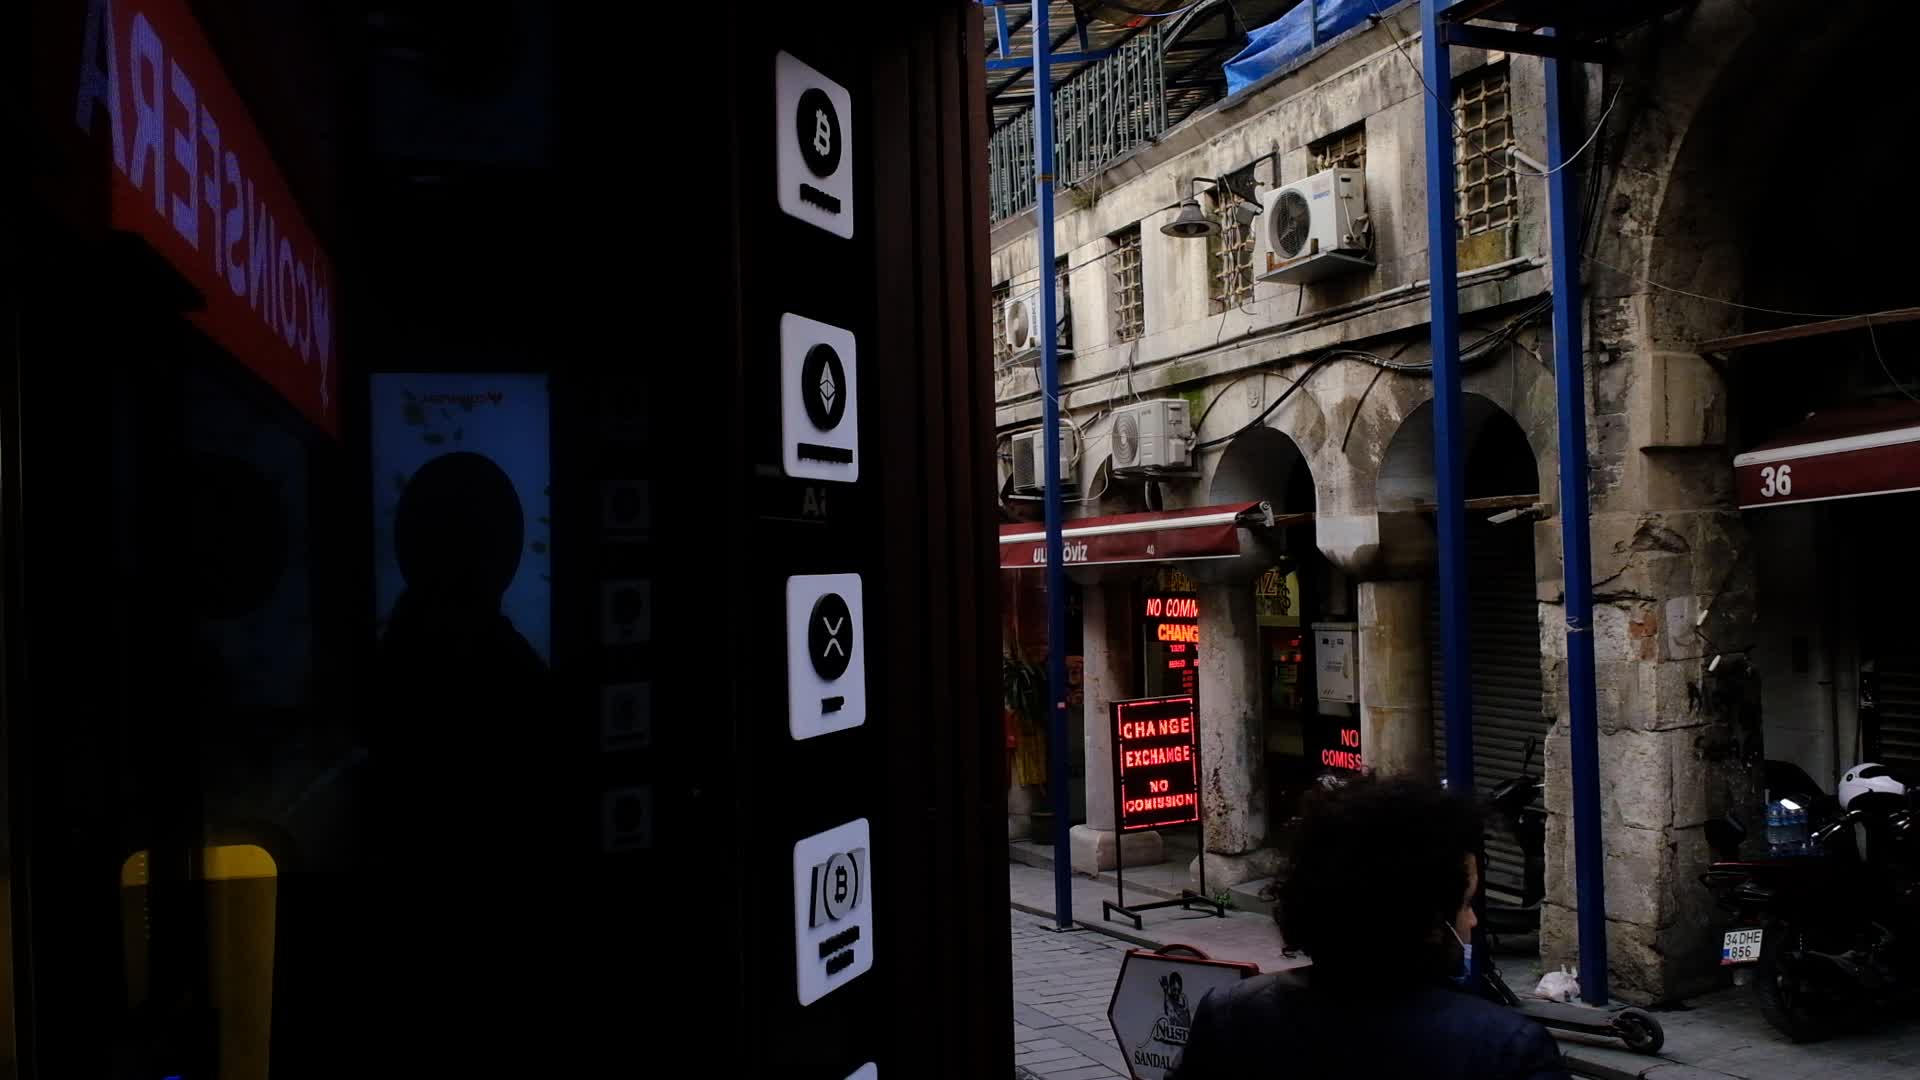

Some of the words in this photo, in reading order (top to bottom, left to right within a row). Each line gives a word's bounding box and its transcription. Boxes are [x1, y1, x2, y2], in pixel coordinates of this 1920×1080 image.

[1760, 463, 1792, 498] 36
[1062, 540, 1088, 562] ÖVİZ
[1146, 598, 1162, 617] NO
[1122, 717, 1190, 739] CHANGE
[1340, 728, 1359, 748] NO
[1125, 745, 1191, 768] EXCHANGE
[1148, 779, 1169, 793] NO
